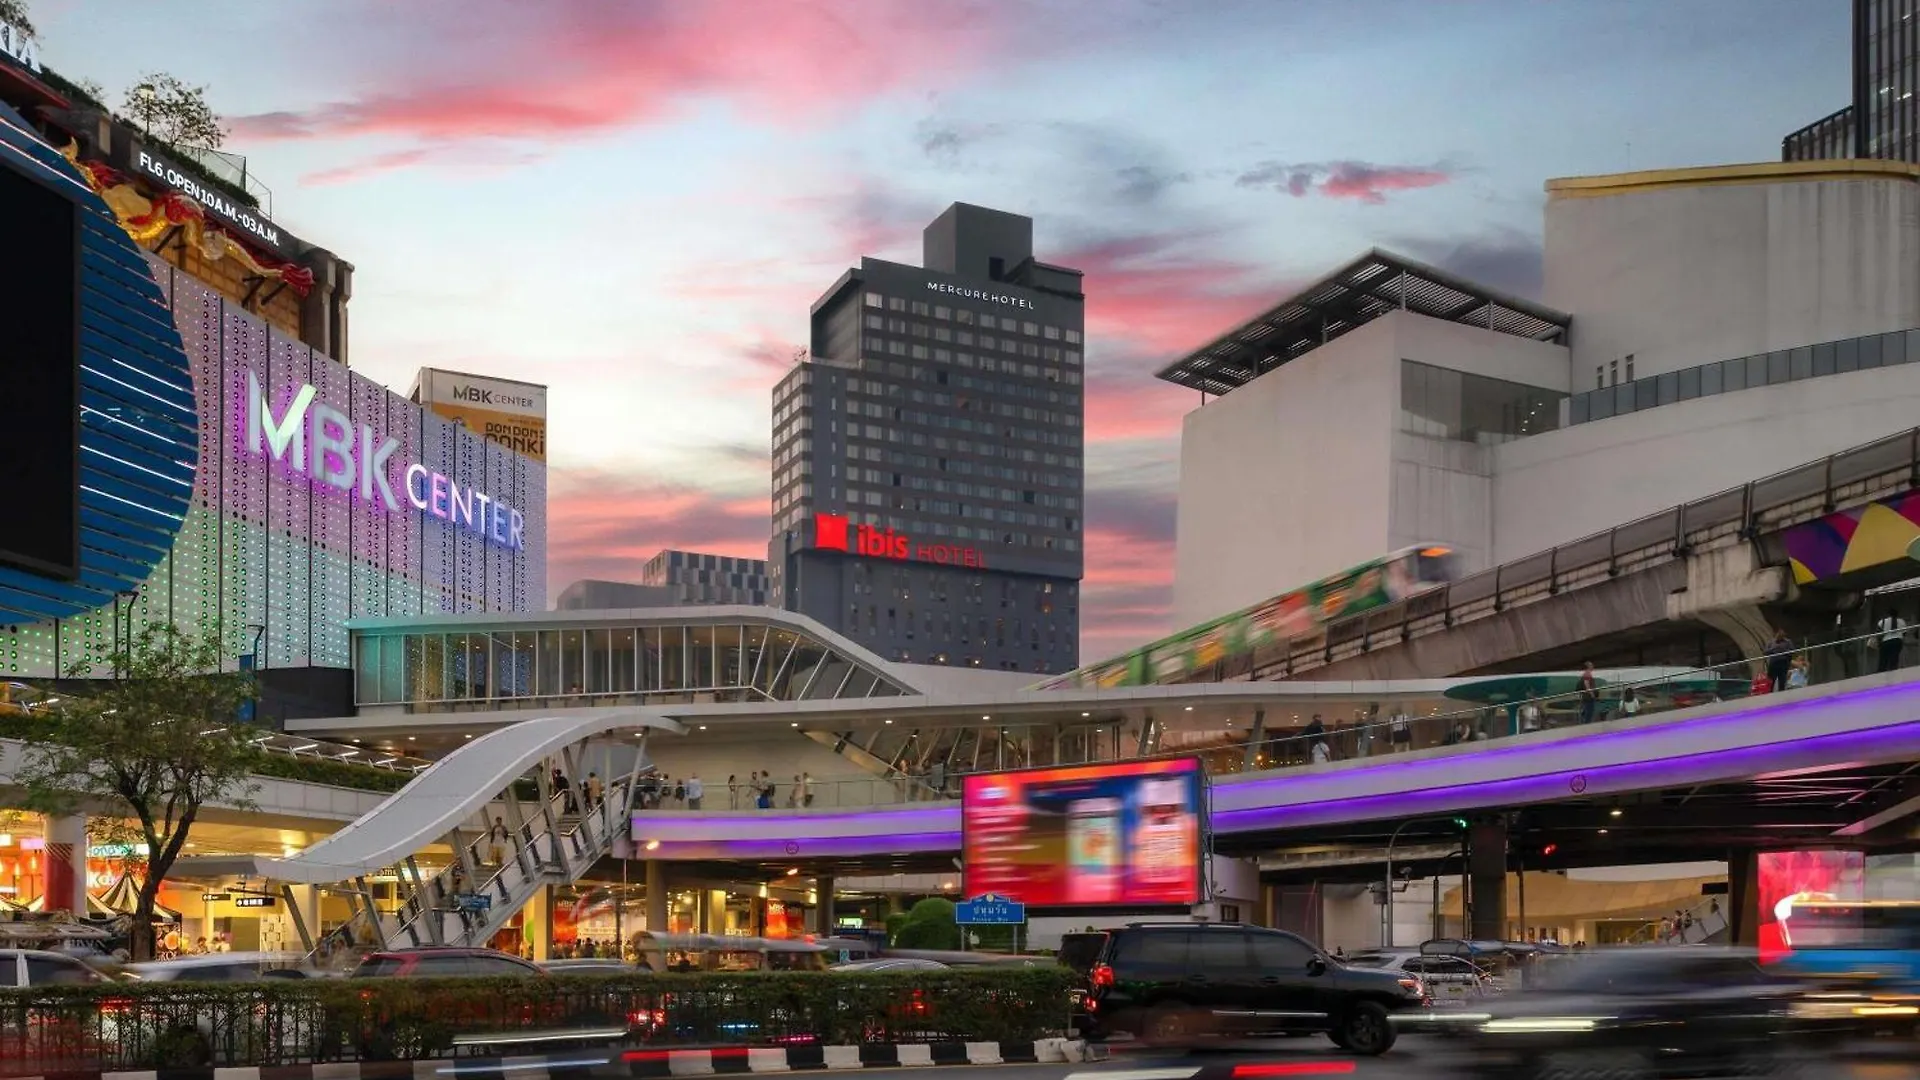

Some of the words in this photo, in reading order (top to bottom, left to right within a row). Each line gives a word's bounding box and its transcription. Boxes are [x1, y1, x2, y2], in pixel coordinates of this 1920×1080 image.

[167, 169, 200, 199] OPEN
[927, 282, 988, 301] MERCURE
[991, 293, 1034, 310] HOTEL
[453, 384, 493, 404] MBK
[493, 394, 533, 408] CENTER
[249, 367, 400, 513] MBK
[405, 462, 524, 551] CENTER
[857, 523, 909, 560] ibis
[916, 543, 987, 569] HOTEL
